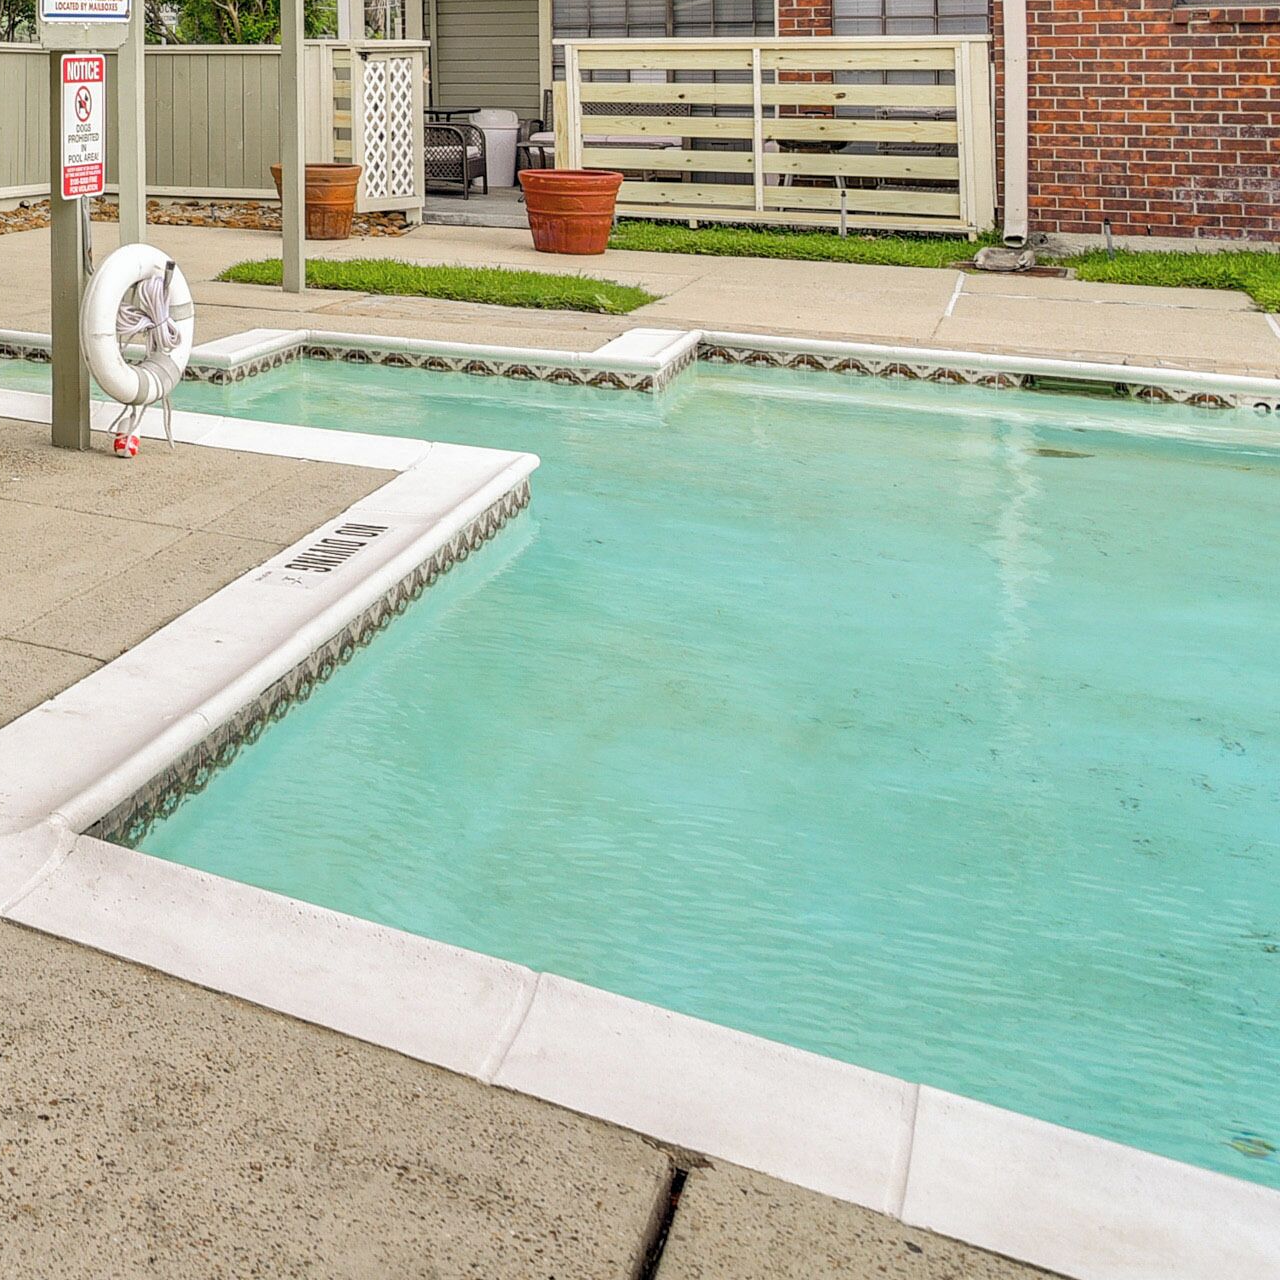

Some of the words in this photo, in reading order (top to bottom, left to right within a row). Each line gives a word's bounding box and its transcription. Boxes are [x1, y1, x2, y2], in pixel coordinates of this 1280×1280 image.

[55, 2, 79, 11] LOCATED
[80, 2, 87, 11] BY
[89, 3, 118, 11] MAILBOXES
[67, 61, 100, 80] NOTICE
[76, 123, 91, 133] DOGS
[68, 132, 99, 144] PROHIBITED
[81, 143, 87, 152] IN
[68, 154, 83, 164] POOL
[334, 523, 389, 538] NO
[284, 538, 368, 573] DIVING
